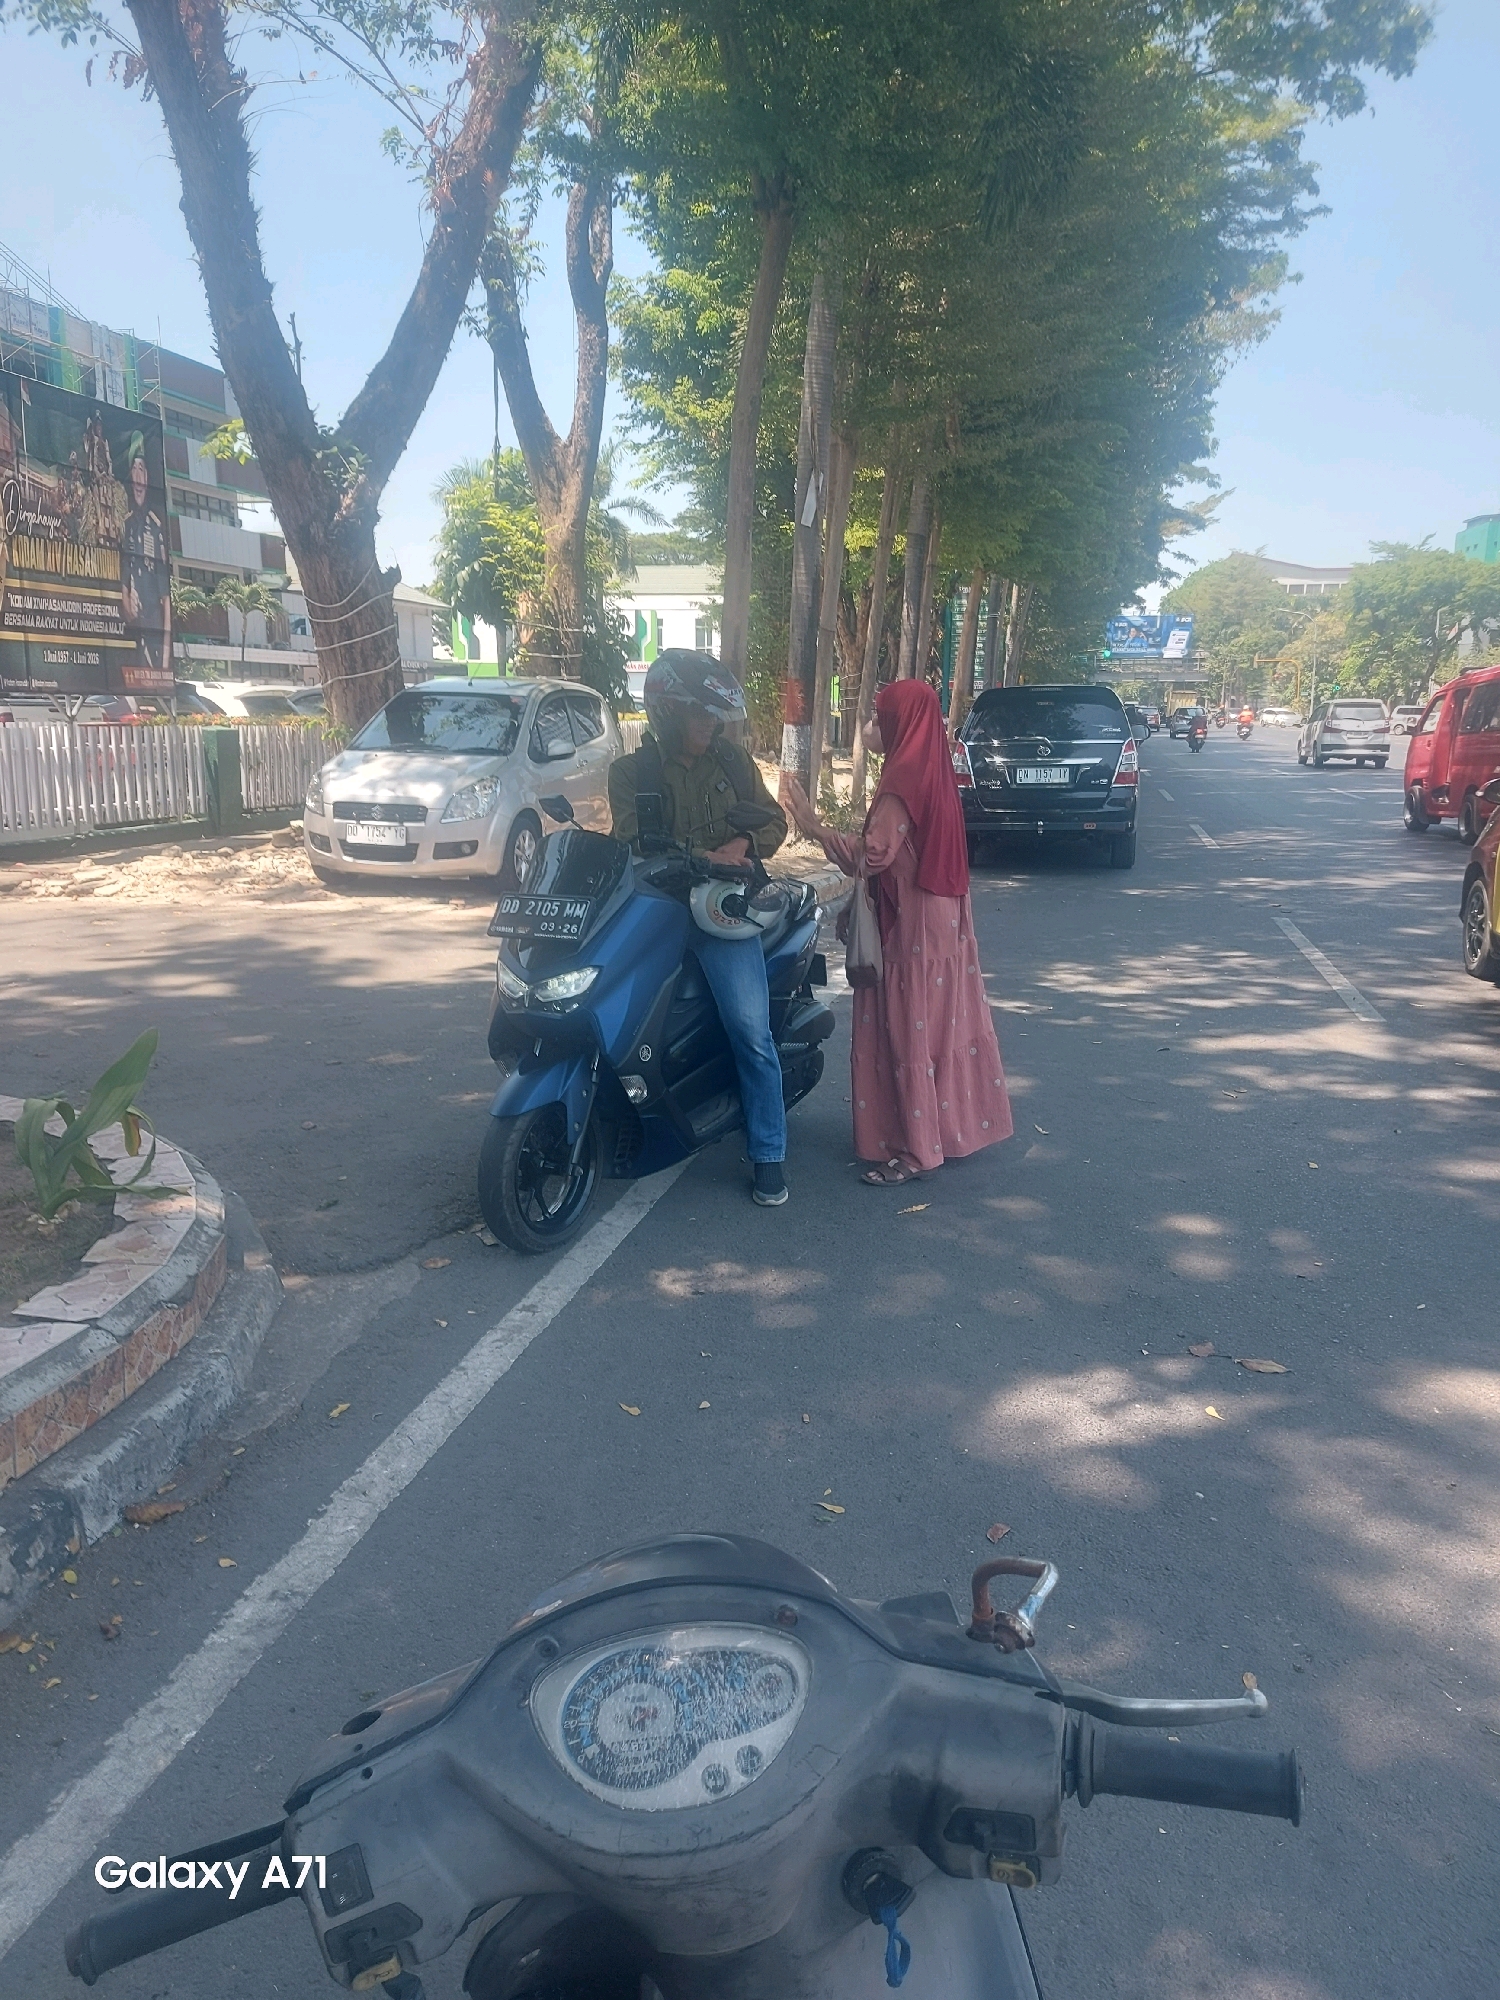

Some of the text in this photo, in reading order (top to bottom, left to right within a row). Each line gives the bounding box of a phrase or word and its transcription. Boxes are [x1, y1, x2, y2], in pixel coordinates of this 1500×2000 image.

[12, 534, 46, 572] KODAM
[82, 602, 120, 618] PROFESIONAL
[4, 612, 35, 628] BERSAMA
[35, 615, 59, 629] RAKYAT
[59, 618, 79, 631] UNTUK
[79, 620, 109, 633] INDONESIA
[501, 899, 586, 918] DD 2105 MM
